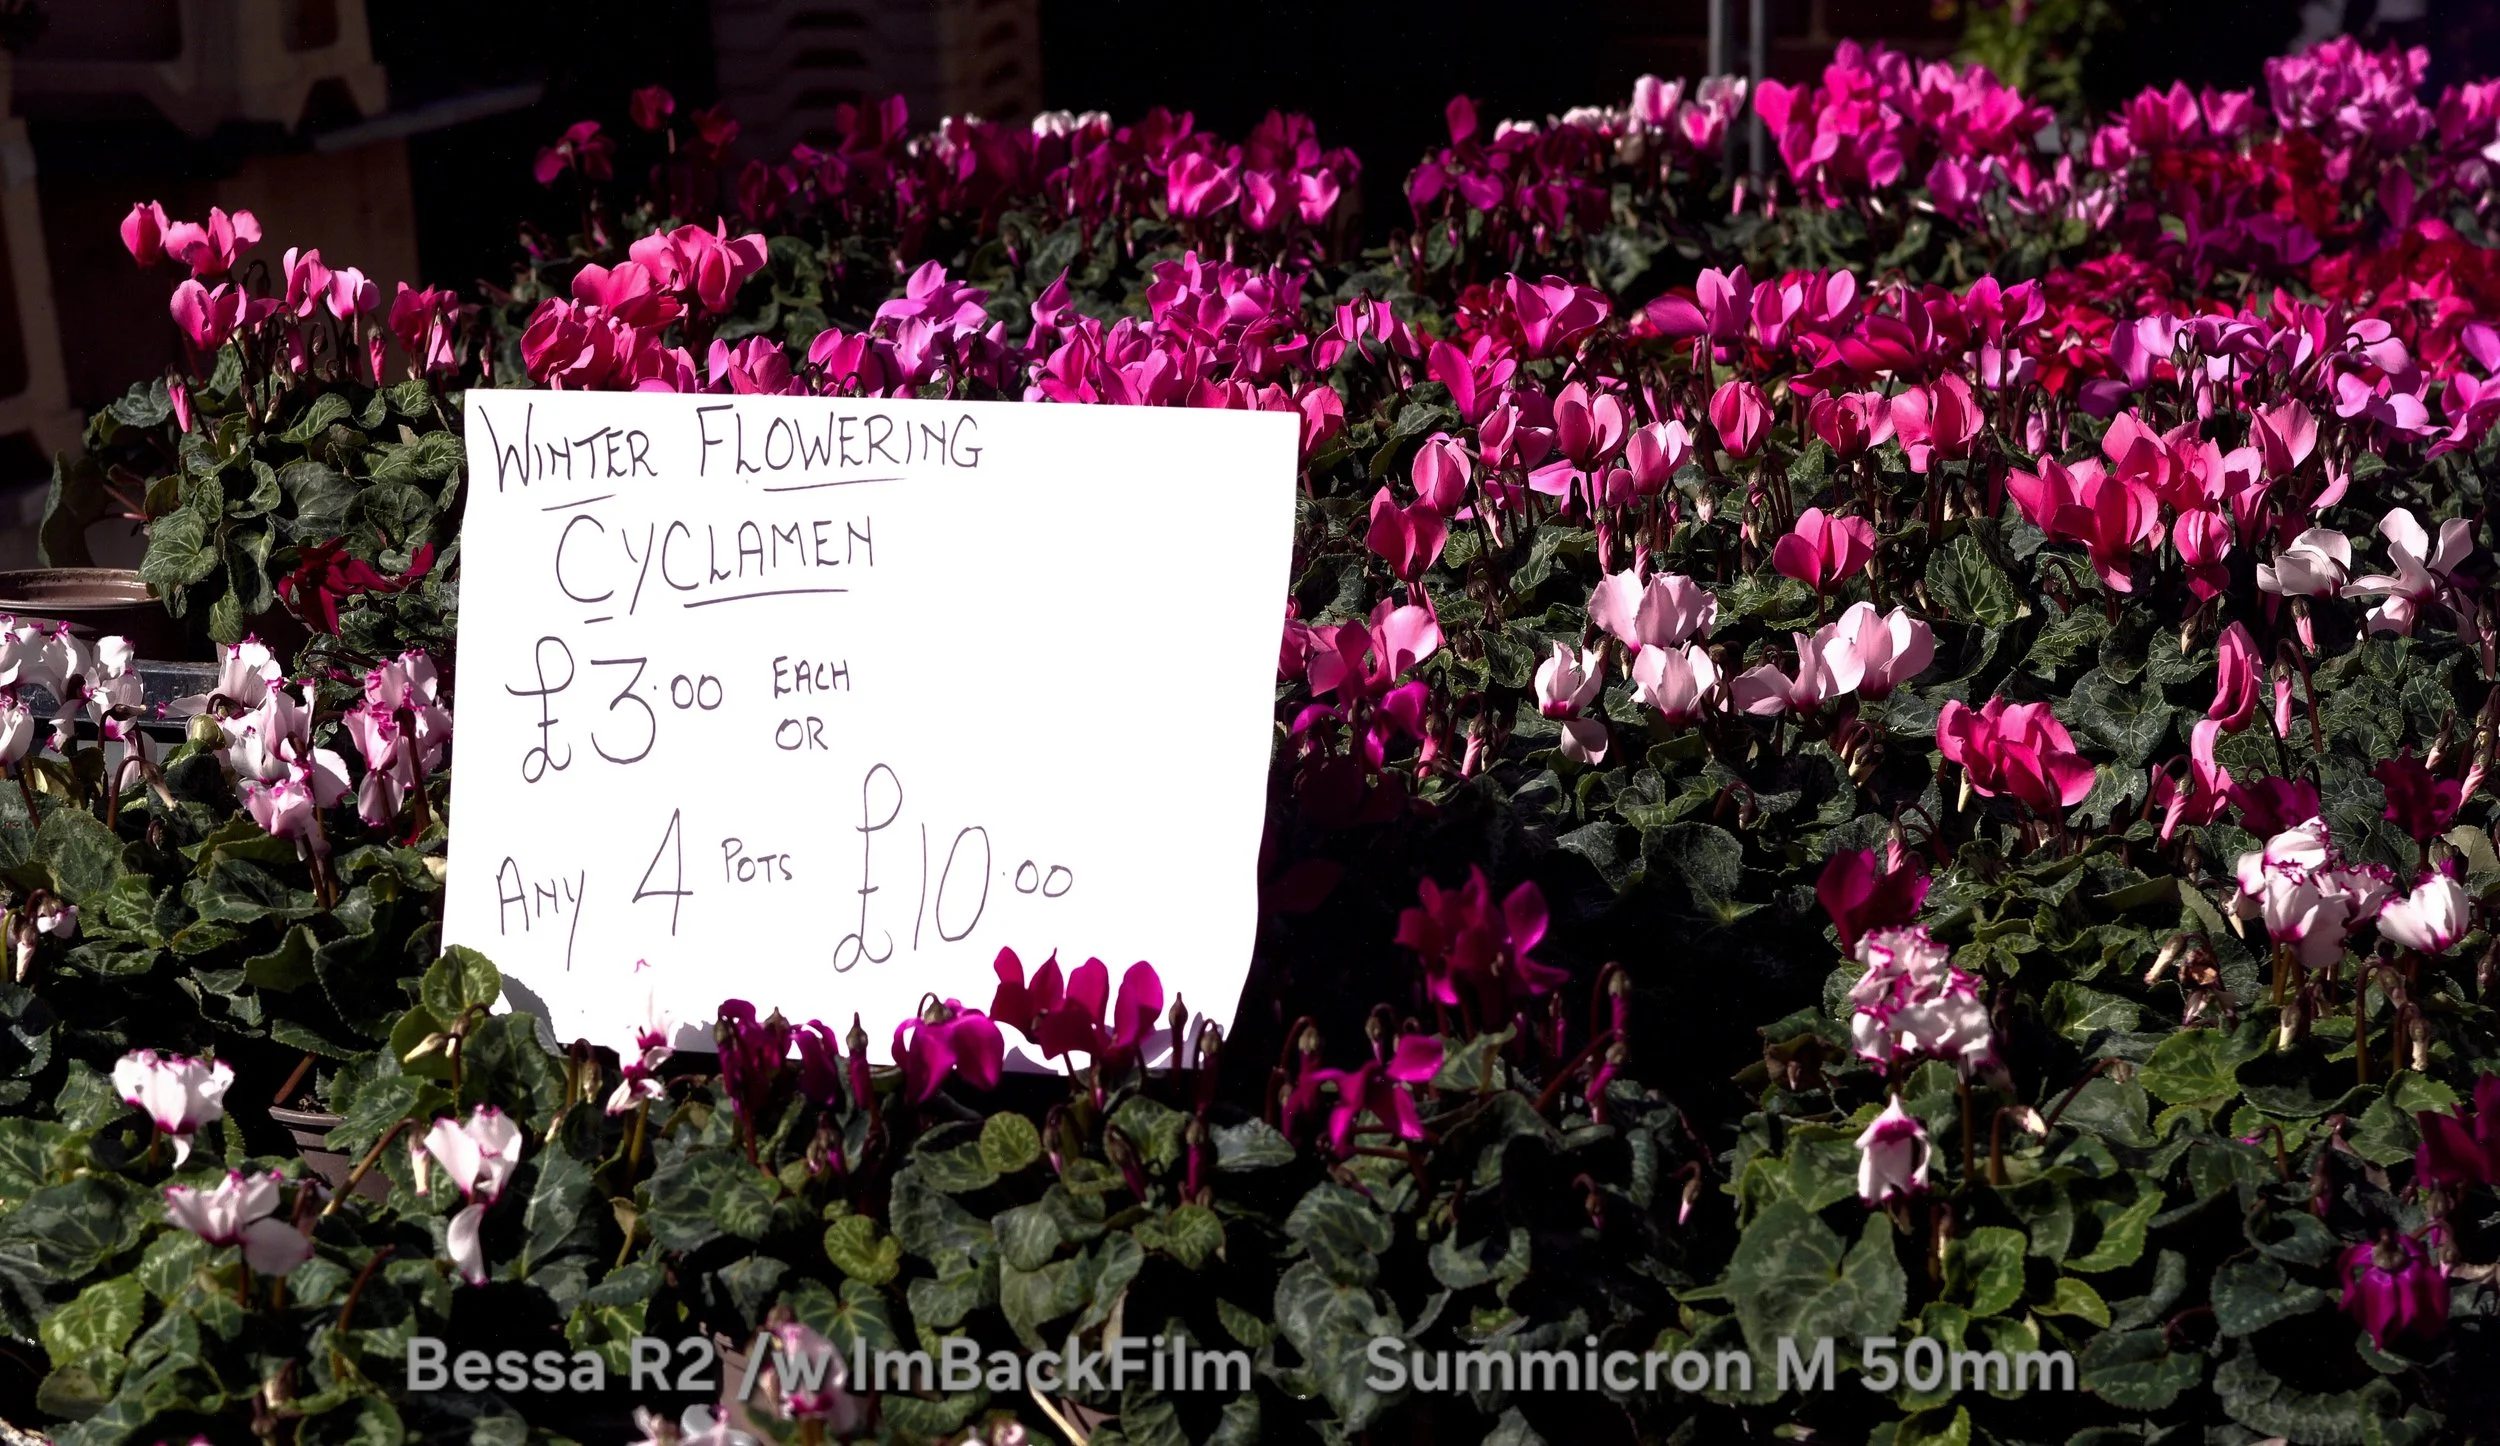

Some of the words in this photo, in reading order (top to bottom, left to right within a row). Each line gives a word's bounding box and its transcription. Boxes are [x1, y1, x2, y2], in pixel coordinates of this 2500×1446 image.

[479, 403, 659, 493] WINTER
[696, 404, 983, 476] FLOWERING
[556, 514, 874, 615] CYCLAMEN
[773, 656, 850, 699] EACH
[775, 716, 829, 751] OR
[496, 856, 585, 971] ANY
[632, 808, 694, 936] 4
[722, 838, 793, 883] POTS
